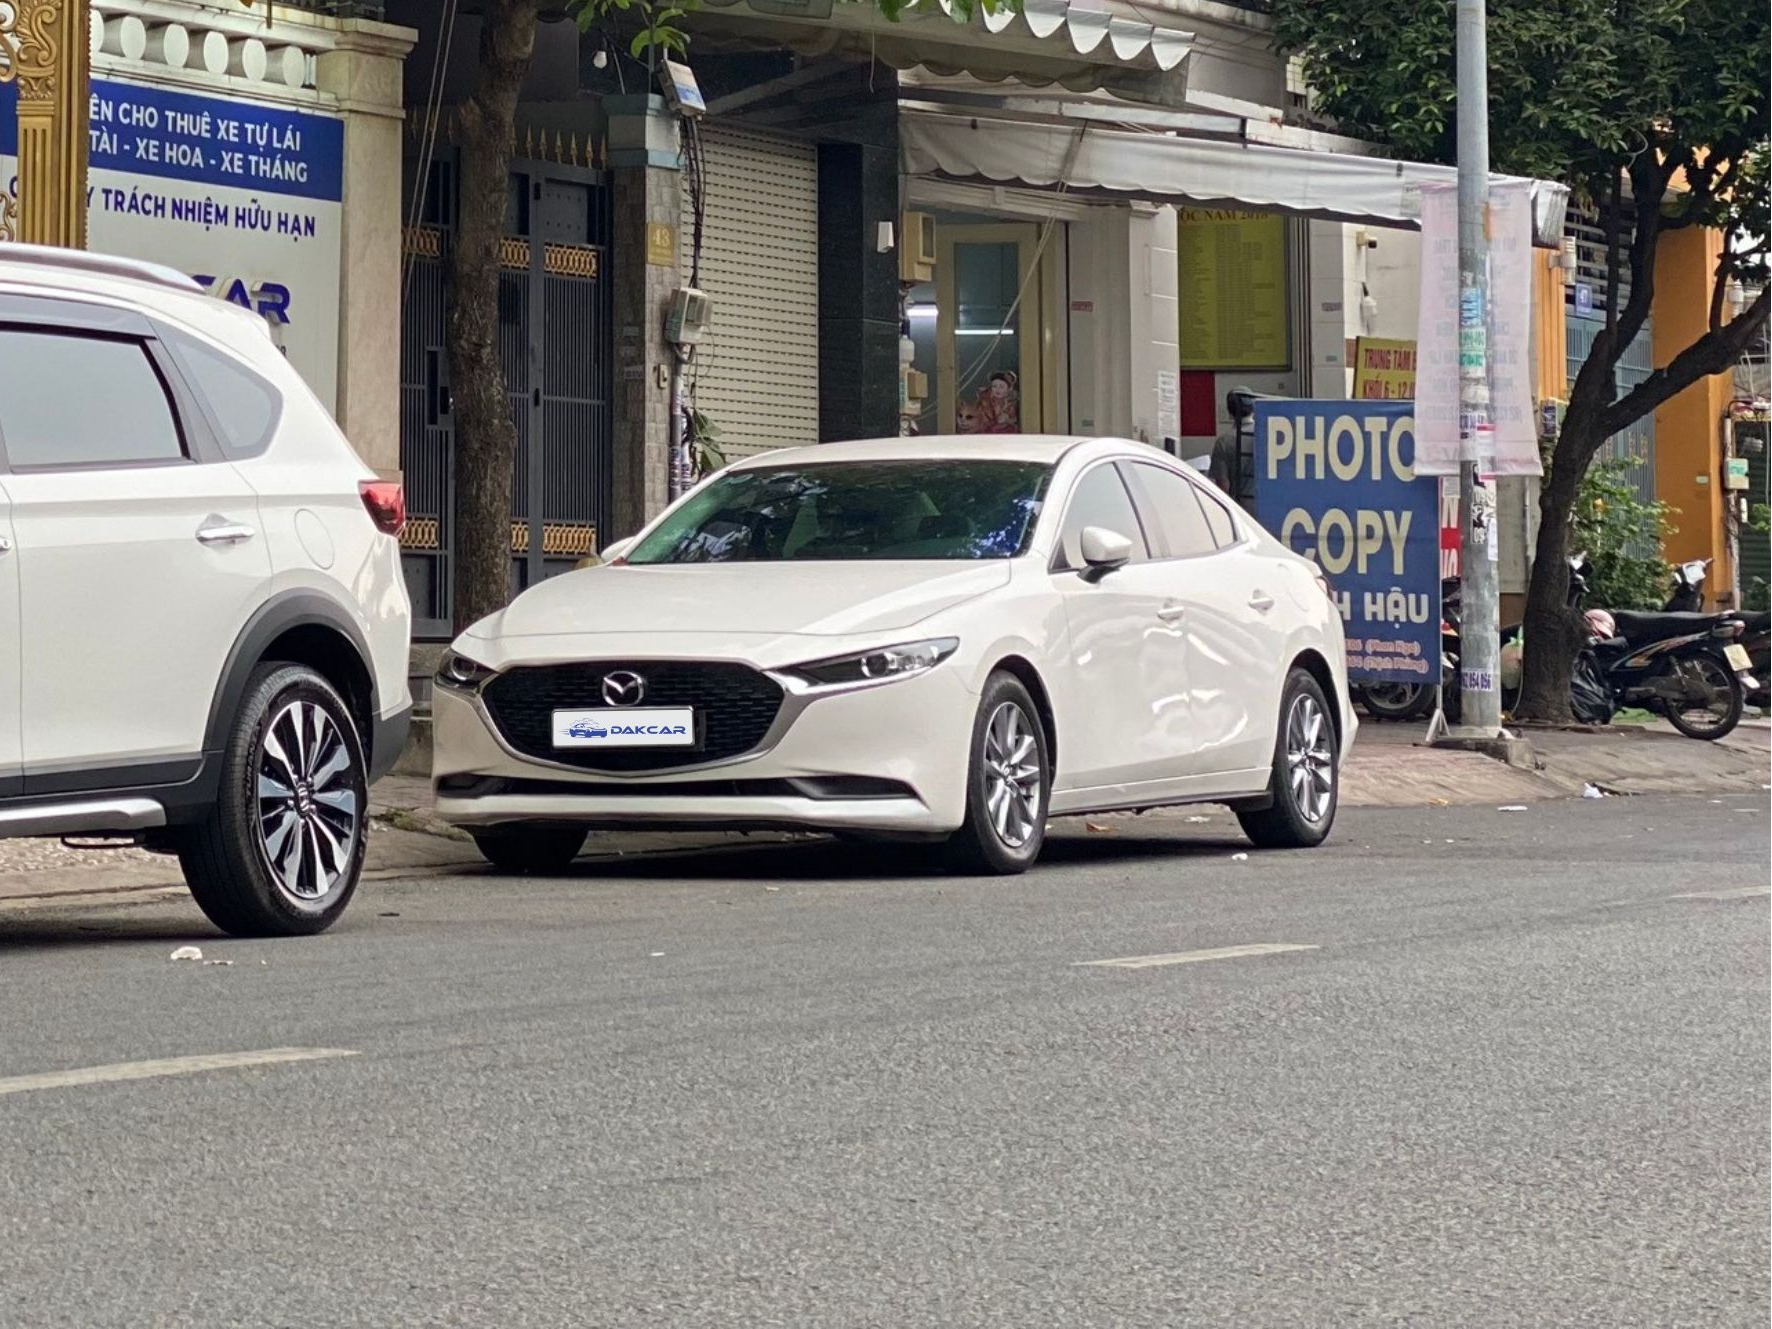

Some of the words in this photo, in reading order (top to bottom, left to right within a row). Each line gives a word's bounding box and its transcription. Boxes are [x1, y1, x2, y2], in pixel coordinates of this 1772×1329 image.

[89, 93, 113, 122] ÊN
[118, 102, 158, 129] CHO
[164, 110, 211, 138] THUÊ
[217, 119, 239, 142] XE
[244, 122, 269, 152] TỰ
[272, 128, 301, 151] LÁI
[89, 125, 117, 155] TÀI
[135, 138, 159, 162] XE
[165, 146, 204, 169] HOA
[221, 152, 243, 174] XE
[248, 155, 308, 183] THÁNG
[102, 185, 166, 218] TRÁCH
[171, 197, 228, 232] NHIỆM
[234, 198, 271, 232] HỮU
[277, 212, 316, 242] HẠN
[652, 228, 670, 247] 43
[1267, 415, 1416, 482] PHOTO
[1281, 508, 1413, 575] COPY
[1364, 587, 1429, 629] HẬU
[610, 725, 687, 735] DAKCAR
